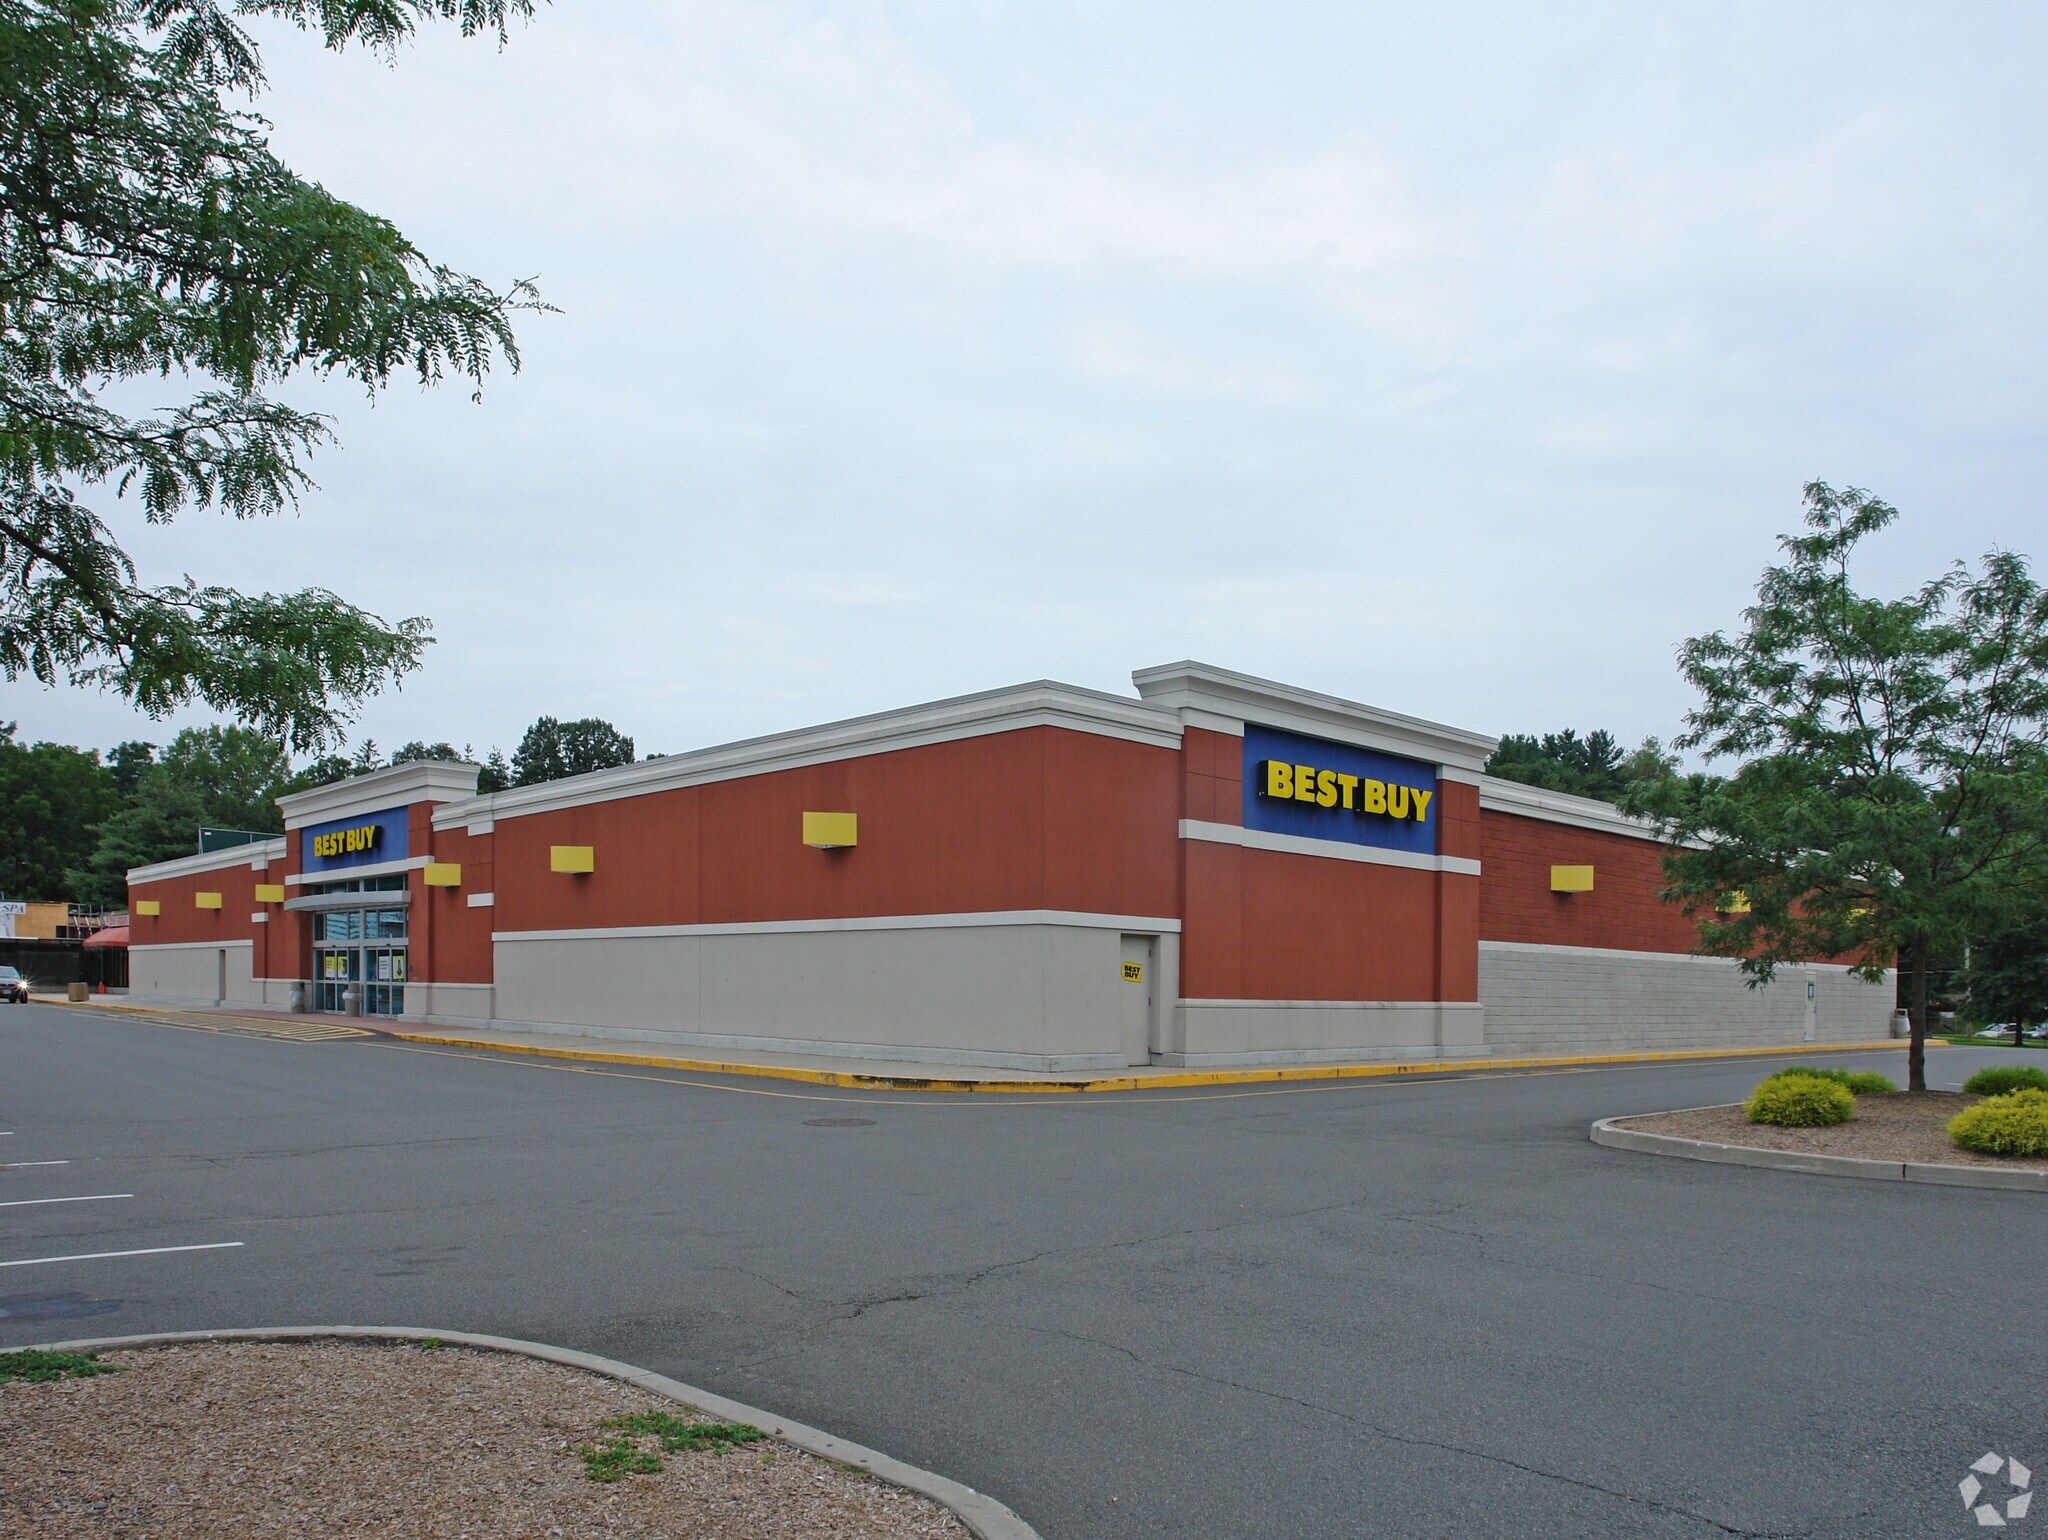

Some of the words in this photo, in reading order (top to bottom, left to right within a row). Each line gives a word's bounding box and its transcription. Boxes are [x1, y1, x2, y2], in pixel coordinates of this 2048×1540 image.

[1268, 760, 1358, 809] BEST
[1365, 778, 1433, 822] BUY
[314, 832, 345, 857] BEST
[346, 825, 375, 852] BUY
[2, 904, 24, 913] SPA
[1124, 965, 1140, 973] BEST
